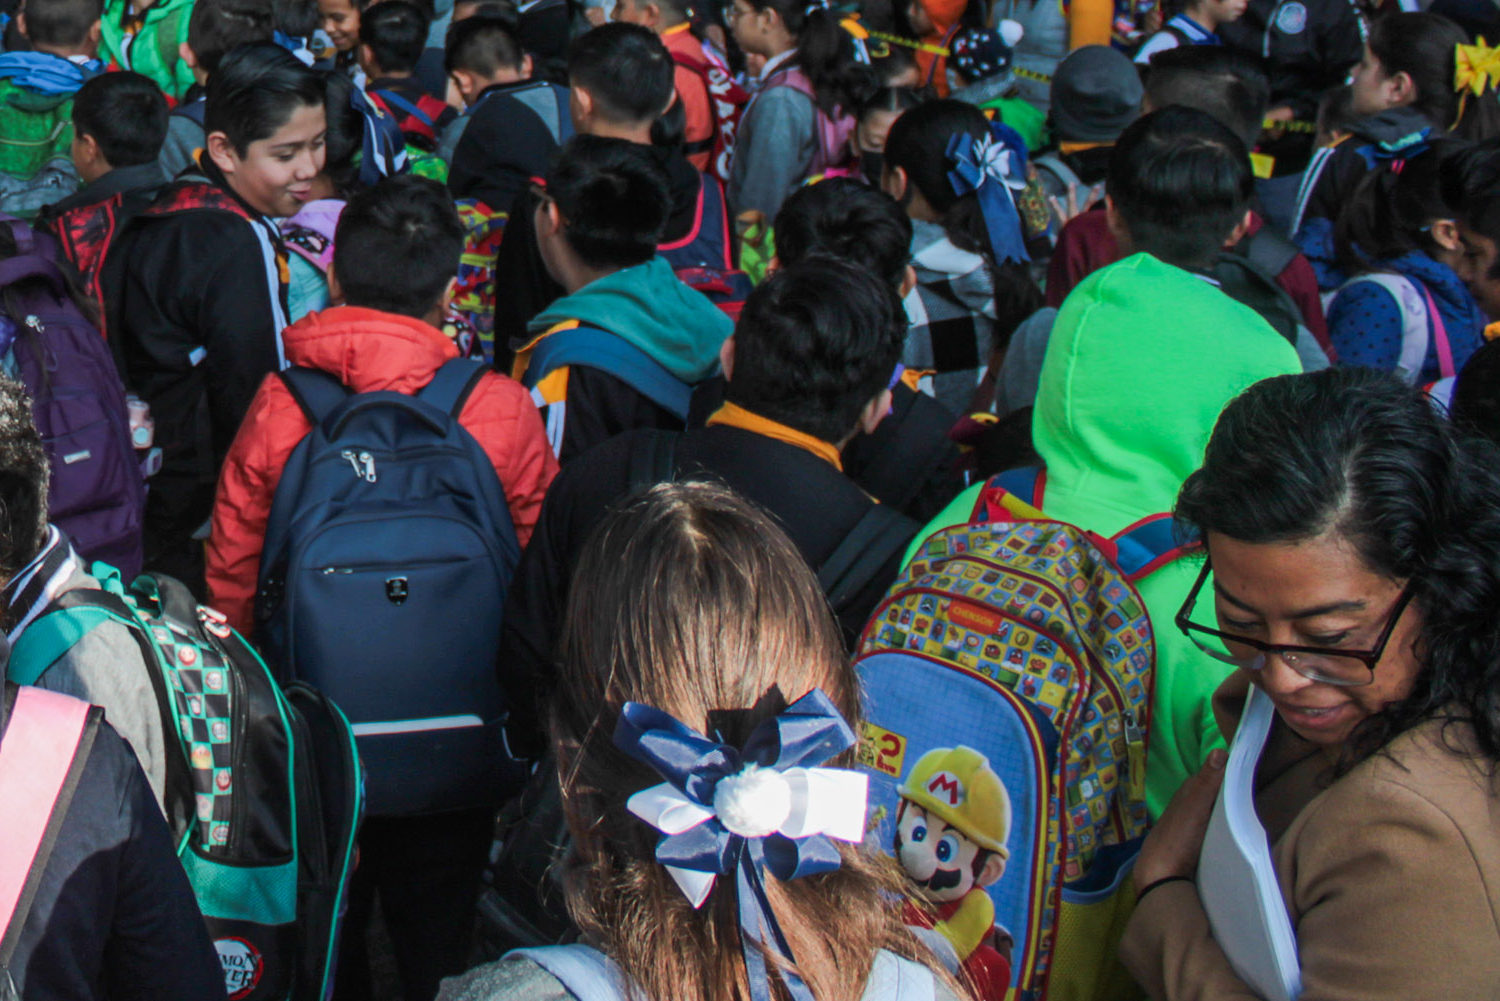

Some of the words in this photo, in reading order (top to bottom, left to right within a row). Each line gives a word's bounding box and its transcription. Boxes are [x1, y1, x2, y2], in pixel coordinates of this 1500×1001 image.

[952, 606, 995, 628] CHENSON
[219, 952, 258, 971] MON
[224, 969, 254, 987] YER
